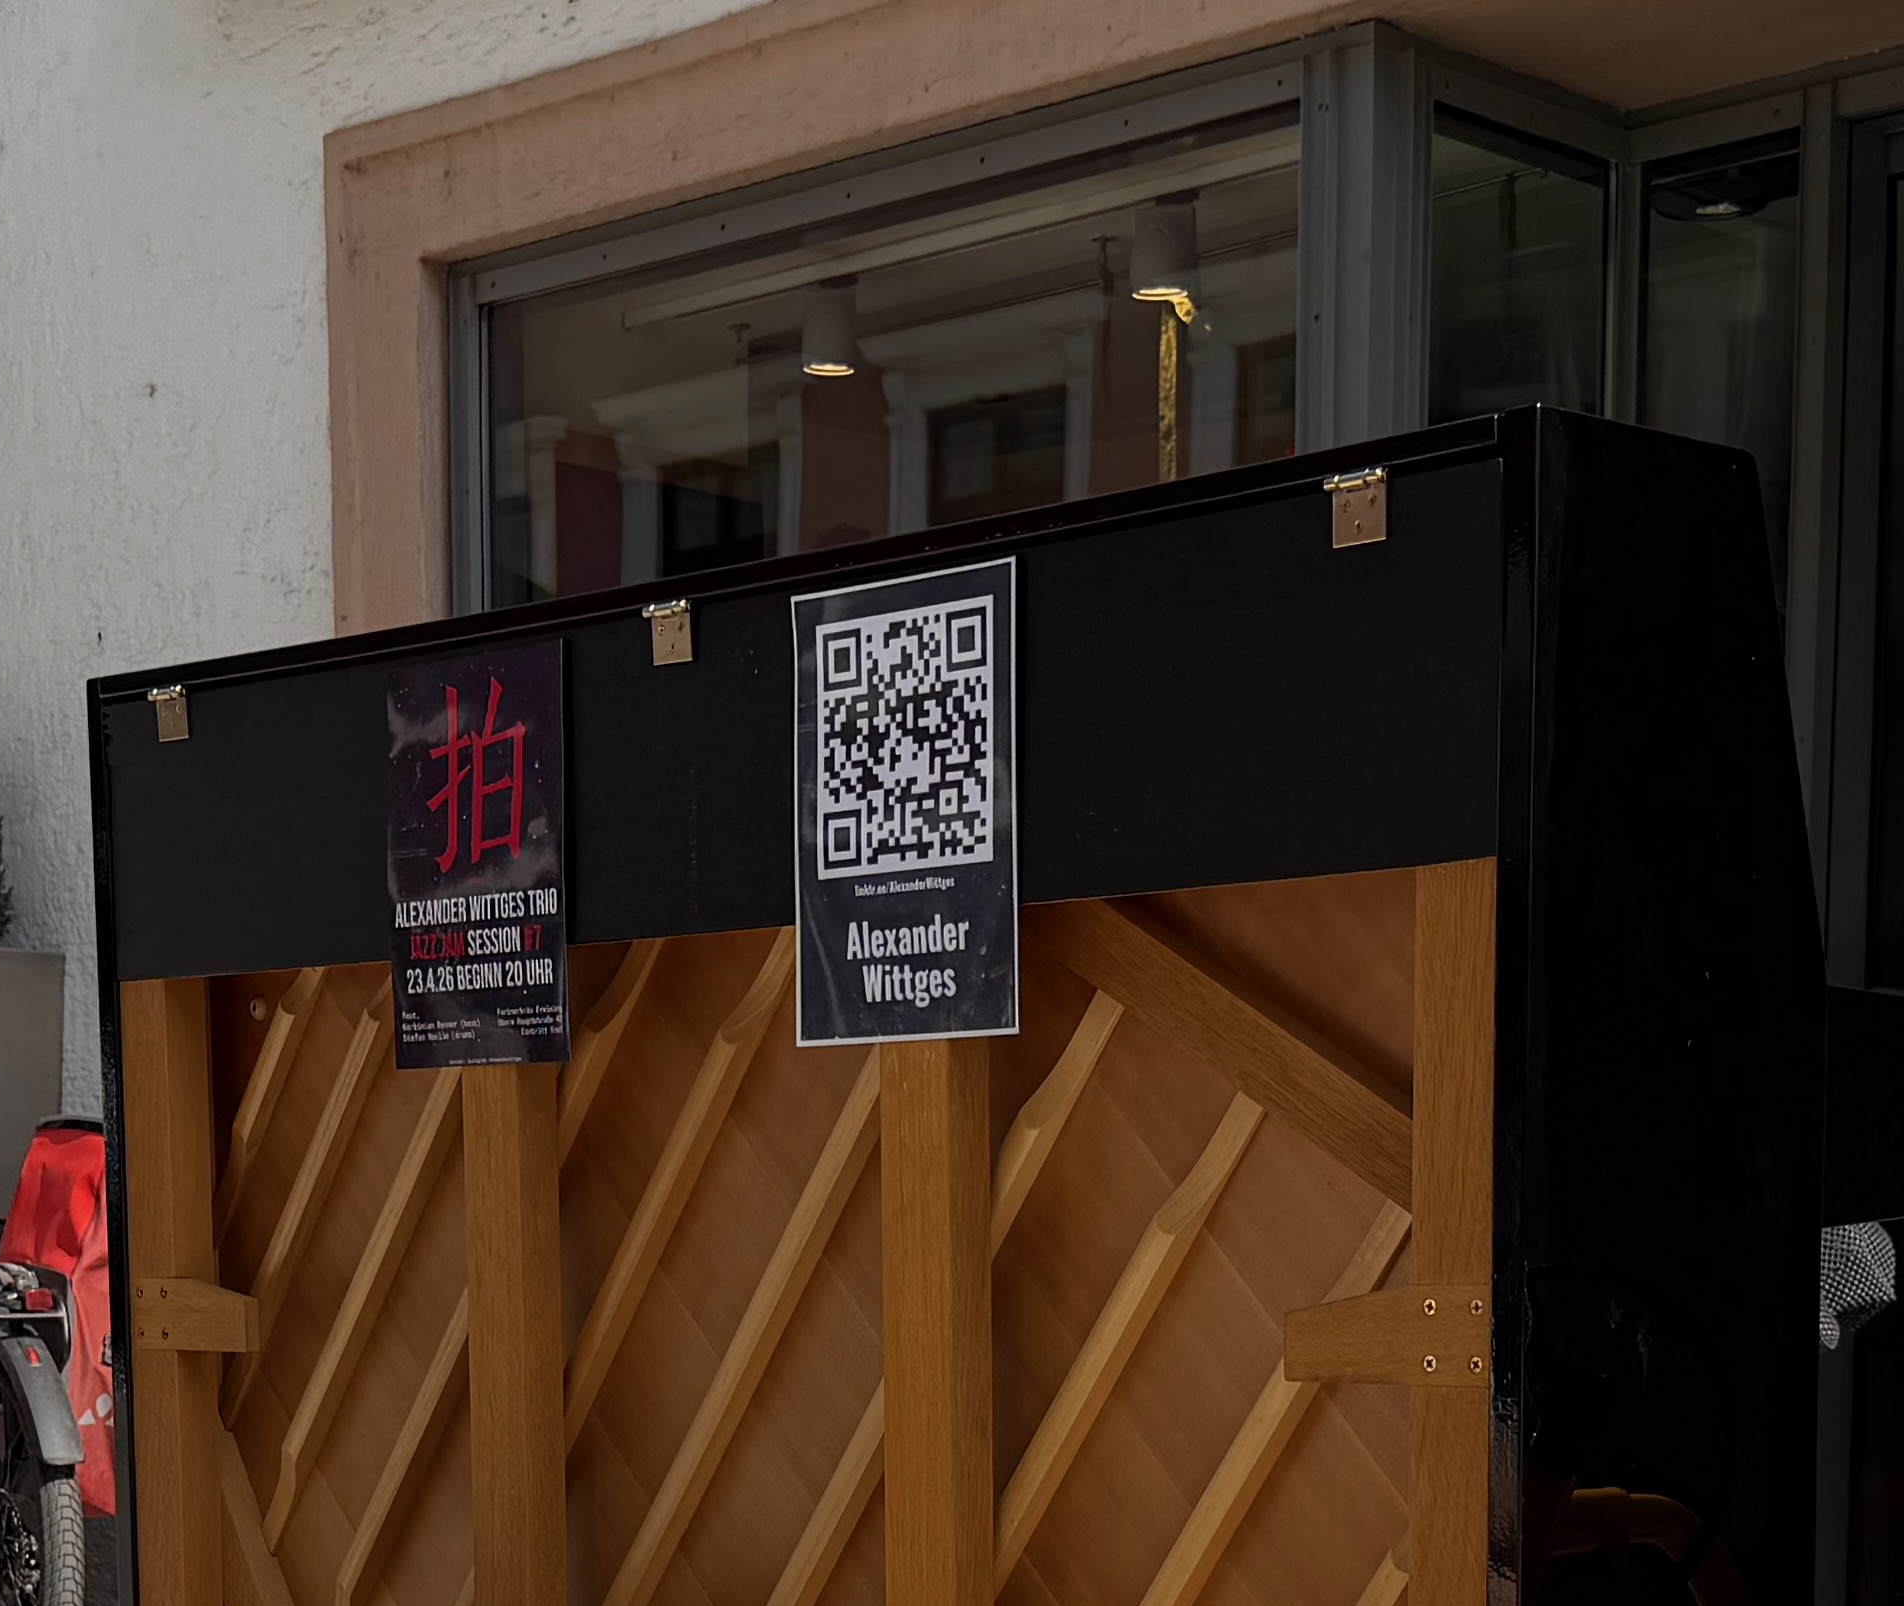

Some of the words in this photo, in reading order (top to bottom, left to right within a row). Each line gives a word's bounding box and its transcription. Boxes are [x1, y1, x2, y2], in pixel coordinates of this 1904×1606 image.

[426, 676, 526, 874] 拍
[395, 897, 467, 928] ALEXANDER
[469, 891, 525, 922] WITTGES
[527, 888, 558, 917] TRIO
[410, 932, 438, 960] JAZZ
[439, 930, 467, 958] JAM
[467, 926, 521, 956] SESSION
[847, 914, 969, 960] Alexander
[406, 965, 454, 994] 23.4.26
[457, 961, 503, 990] BEGINN
[506, 960, 522, 987] 20
[526, 958, 554, 985] UHR
[862, 964, 957, 1008] Wittges
